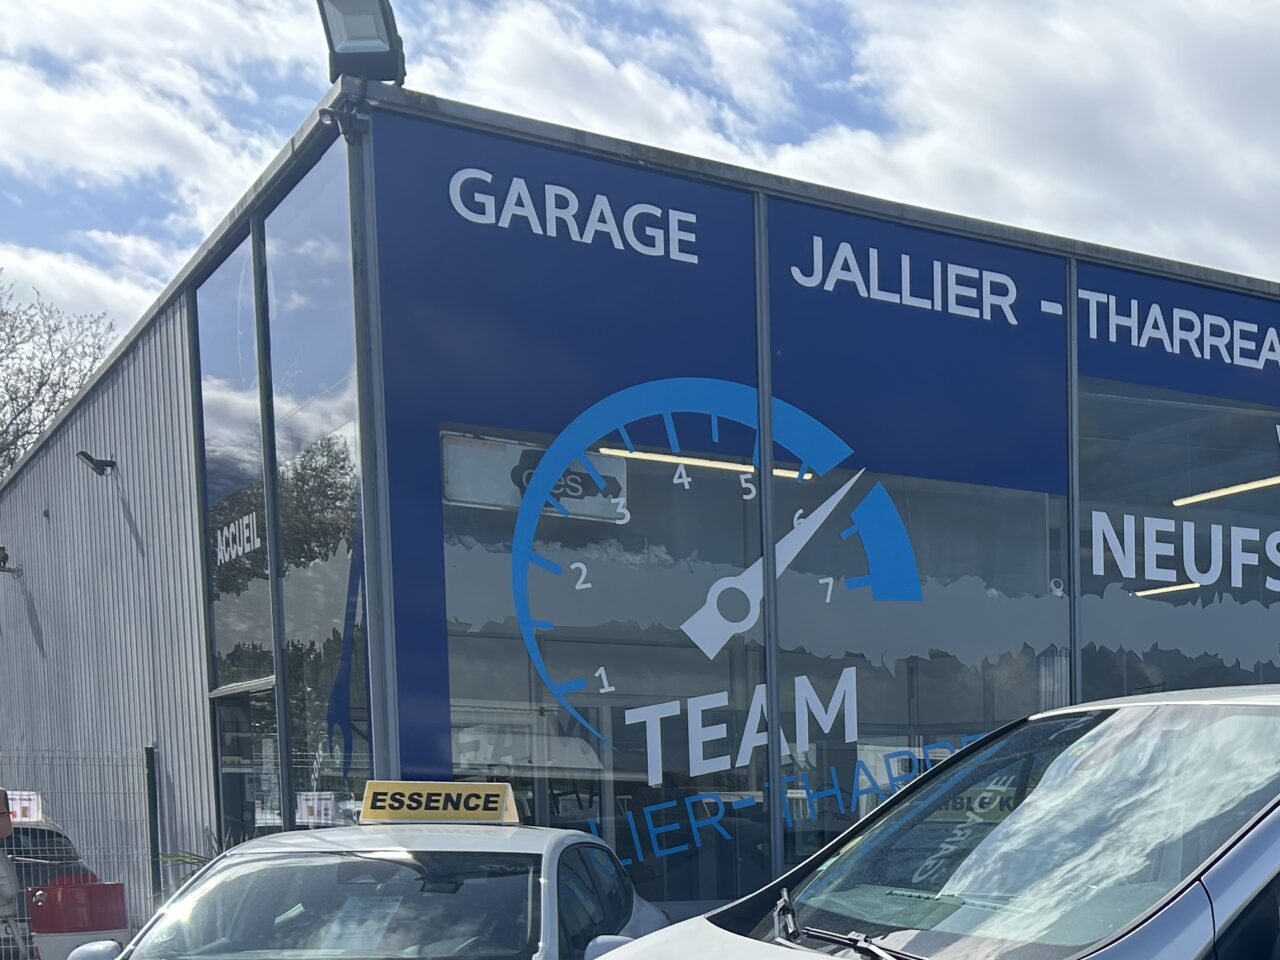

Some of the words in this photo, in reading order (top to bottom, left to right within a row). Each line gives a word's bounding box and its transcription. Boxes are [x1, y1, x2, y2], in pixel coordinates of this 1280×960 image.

[449, 167, 699, 265] GARAGE
[790, 235, 1018, 325] JALLIER
[672, 464, 693, 491] 4
[614, 498, 631, 525] 3
[217, 511, 260, 566] ACCUEIL
[572, 562, 592, 590] 2
[818, 577, 834, 604] 7
[593, 666, 616, 695] 1
[625, 666, 859, 787] TEAM
[370, 791, 500, 812] ESSENCE
